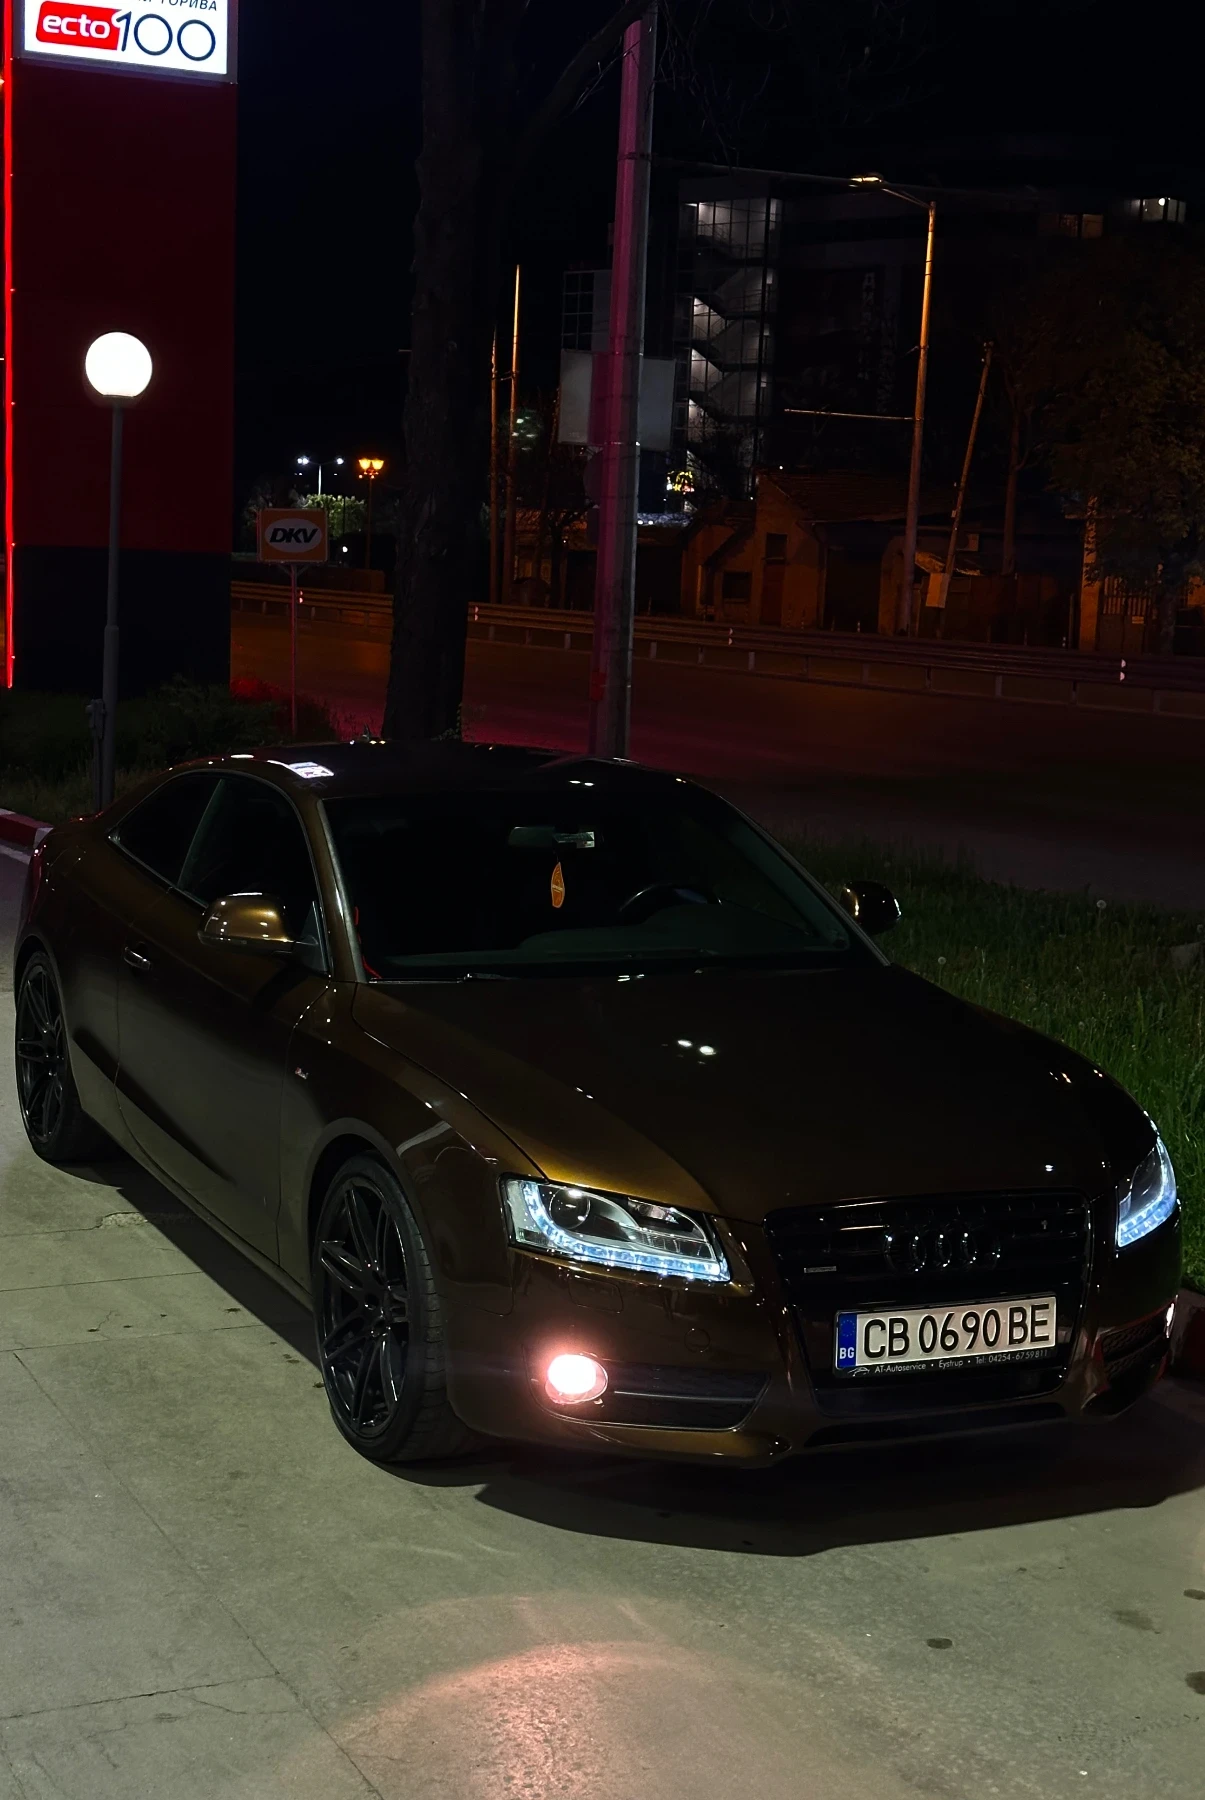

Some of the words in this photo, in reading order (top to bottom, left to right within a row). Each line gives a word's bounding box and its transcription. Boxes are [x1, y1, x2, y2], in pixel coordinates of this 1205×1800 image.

[42, 13, 111, 39] ecto
[116, 11, 216, 61] 100
[270, 528, 318, 543] DKV
[863, 1317, 910, 1359] CB
[918, 1308, 1001, 1354] 0690
[1008, 1303, 1050, 1345] BE
[839, 1347, 855, 1360] BG
[874, 1362, 927, 1374] AT-Autoservice
[938, 1359, 964, 1369] Eystrup
